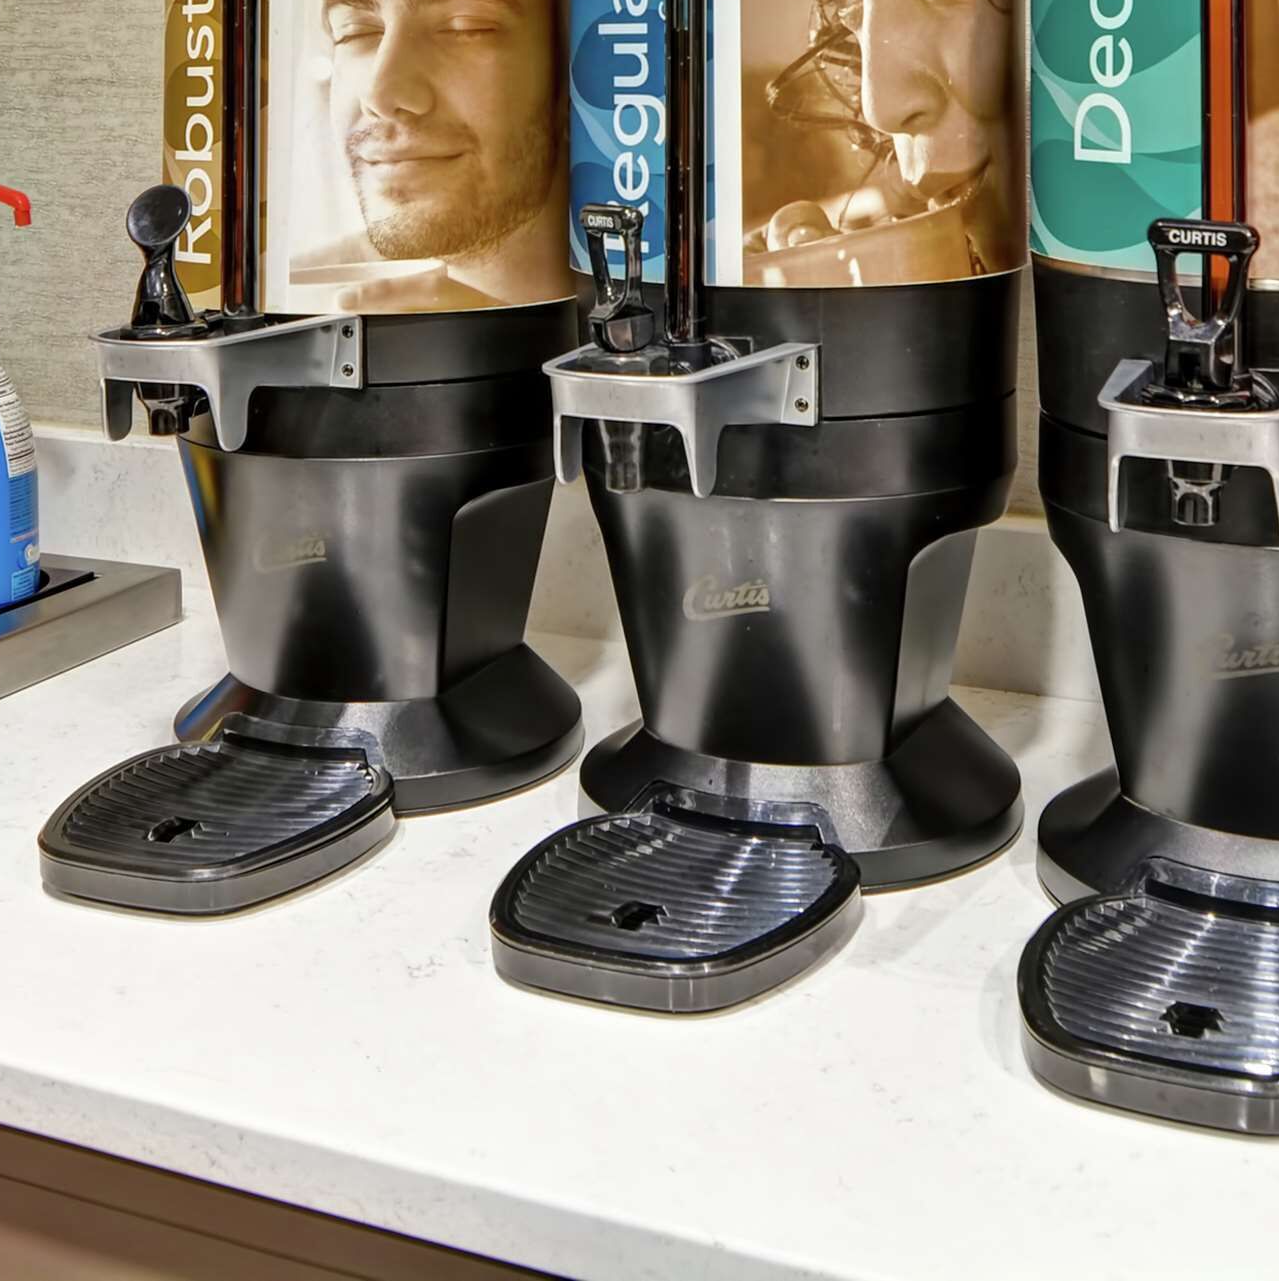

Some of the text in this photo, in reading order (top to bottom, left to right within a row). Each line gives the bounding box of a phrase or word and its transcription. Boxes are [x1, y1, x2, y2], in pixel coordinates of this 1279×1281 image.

[587, 215, 614, 230] CURTIS
[1168, 229, 1228, 247] CURTIS
[682, 575, 770, 621] Curtis
